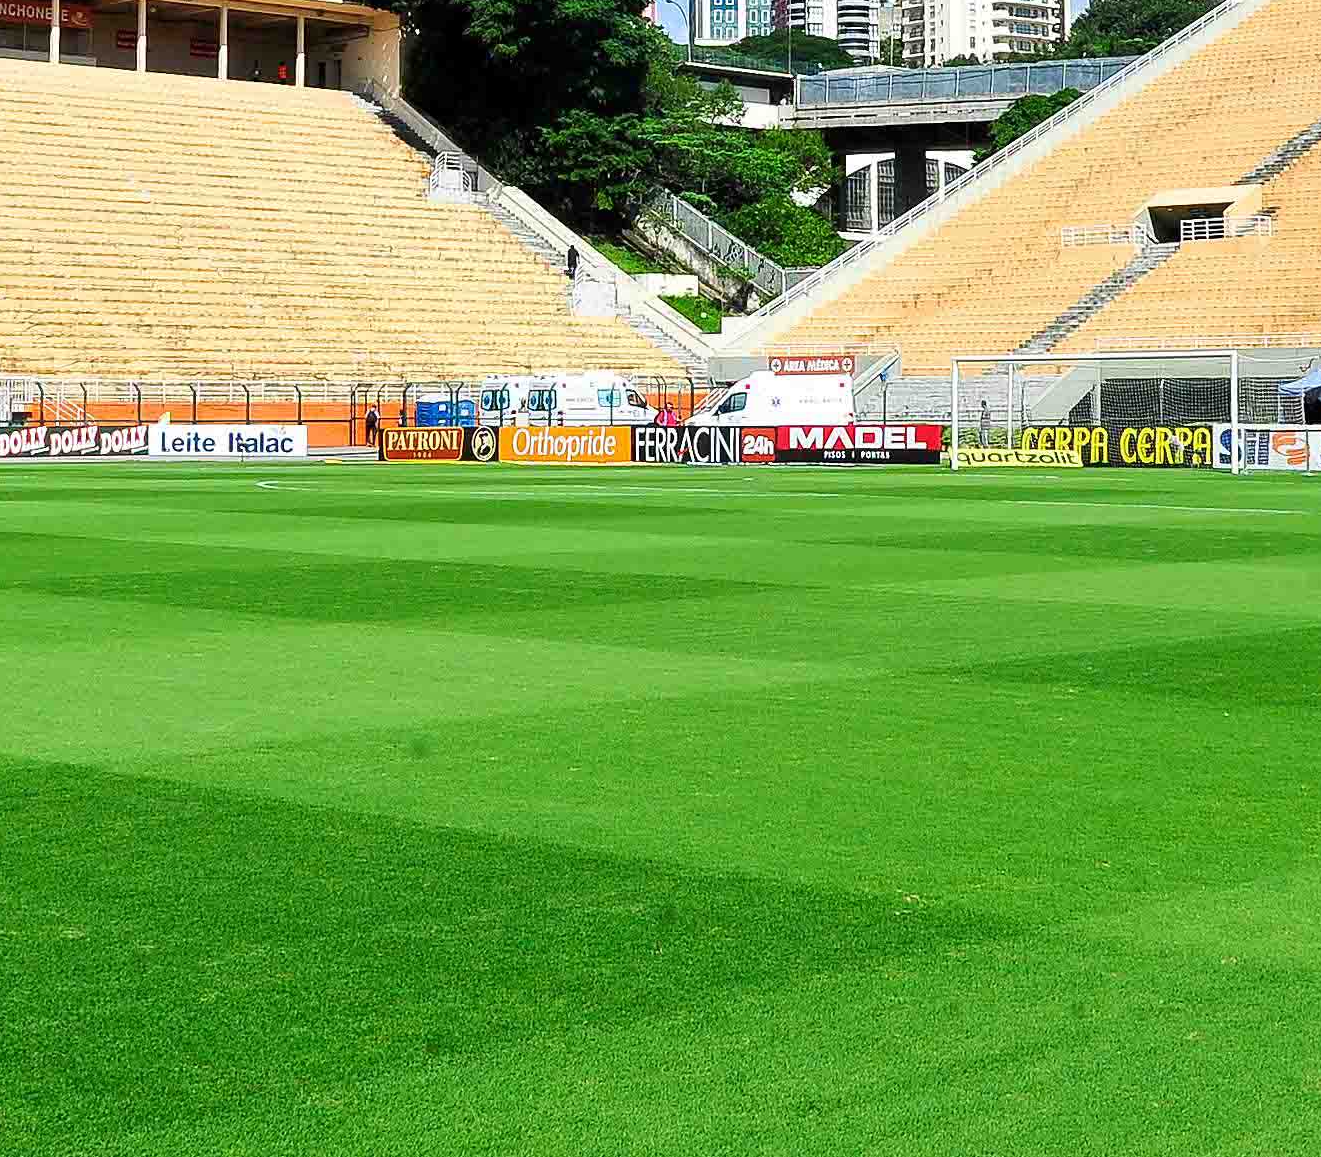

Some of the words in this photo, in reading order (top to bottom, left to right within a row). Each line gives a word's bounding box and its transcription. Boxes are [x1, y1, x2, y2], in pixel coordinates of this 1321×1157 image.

[50, 426, 99, 455] DOLLY
[100, 425, 148, 455] DOLLY
[161, 431, 216, 453] Leite
[228, 431, 294, 453] Italac
[387, 430, 459, 451] PATRONI
[512, 428, 616, 461] Orthopride
[635, 427, 740, 463] FERRACINI
[743, 434, 774, 456] 24h
[789, 426, 927, 450] MADEL
[1022, 427, 1109, 464] CERPA
[1119, 427, 1212, 465] CERPA
[823, 450, 847, 460] PISOS
[956, 451, 1079, 466] quartzolit
